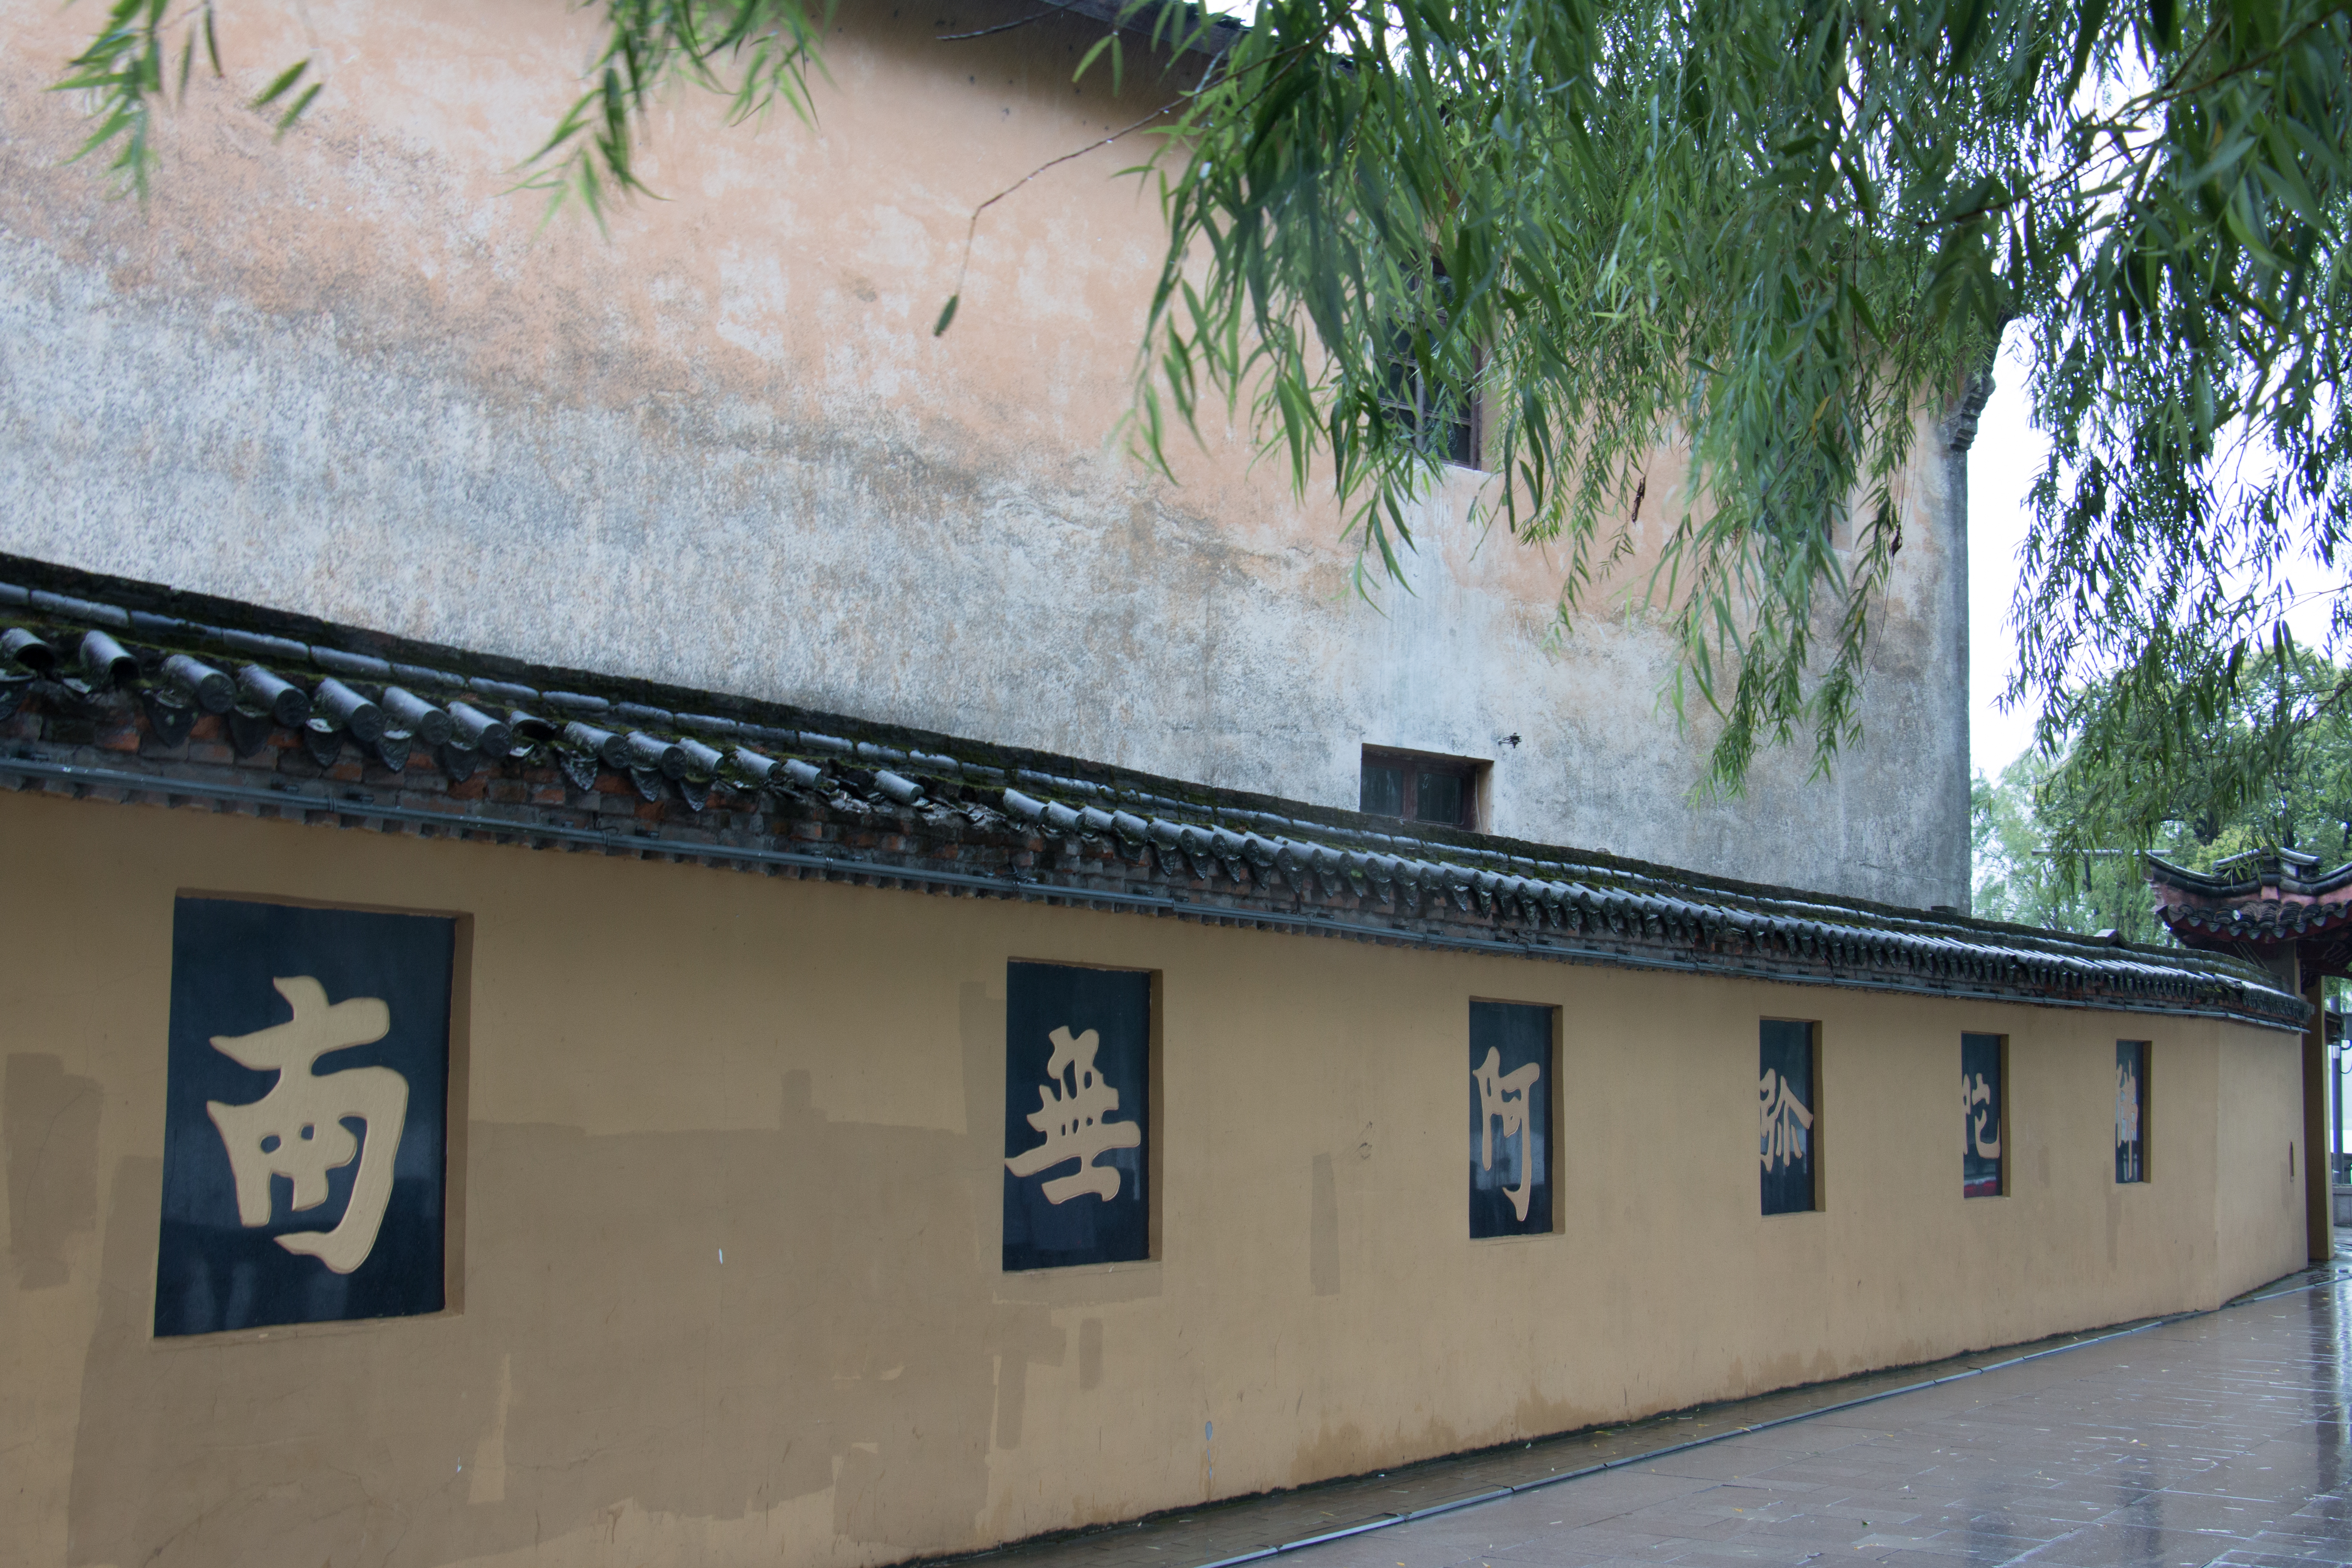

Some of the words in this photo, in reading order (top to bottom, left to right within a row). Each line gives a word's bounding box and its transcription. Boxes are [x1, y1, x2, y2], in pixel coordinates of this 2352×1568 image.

[206, 975, 409, 1274] 南
[1004, 1026, 1141, 1204] 無
[1473, 1046, 1540, 1222] 阿
[1760, 1068, 1813, 1173] 弥
[1962, 1073, 2000, 1159] 陀
